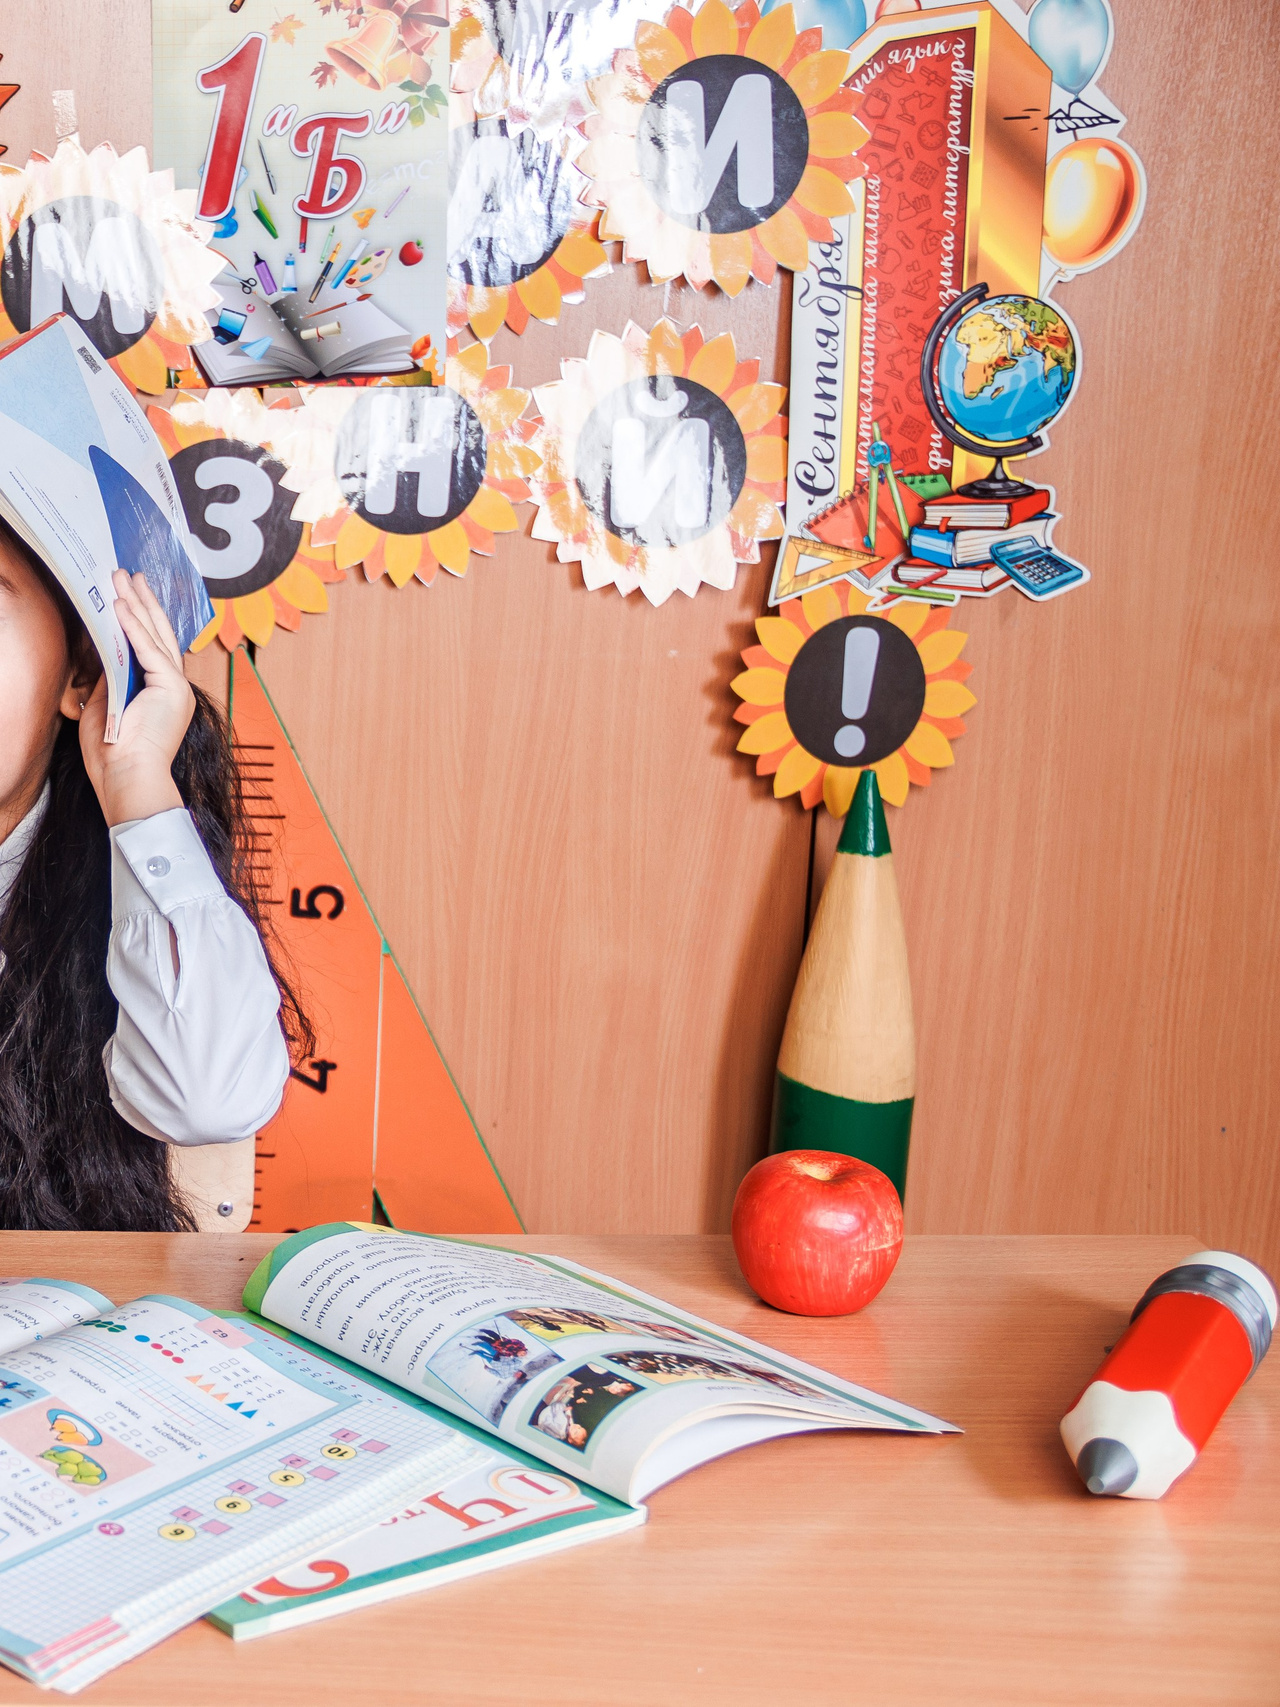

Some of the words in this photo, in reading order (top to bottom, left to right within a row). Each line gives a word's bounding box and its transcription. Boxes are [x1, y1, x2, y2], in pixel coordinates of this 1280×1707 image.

[884, 39, 950, 74] язык
[196, 32, 267, 221] 1
[669, 73, 775, 215] И
[950, 36, 979, 227] литература
[863, 173, 882, 268] химия
[30, 217, 148, 335] М
[794, 229, 864, 507] Сентября
[855, 276, 878, 479] математика
[364, 395, 457, 517] Н
[609, 383, 711, 529] Й
[833, 626, 881, 758] !
[290, 884, 344, 920] 5
[289, 1058, 338, 1094] 4
[296, 1247, 349, 1289] вопросов.
[299, 1260, 354, 1323] поработать!
[313, 1272, 359, 1330] Молодцы!
[355, 1266, 419, 1310] достижения
[375, 1288, 415, 1321] работу.
[2, 1312, 29, 1329] Какие
[336, 1314, 353, 1341] нам
[389, 1305, 410, 1324] что
[211, 1327, 229, 1339] 62
[360, 1328, 377, 1354] Эти
[370, 1327, 388, 1357] нуж-
[379, 1306, 423, 1363] встречать
[404, 1321, 444, 1375] интерес-
[113, 1399, 142, 1419] такие
[150, 1423, 192, 1452] Начерти
[326, 1442, 348, 1460] 10
[278, 1471, 294, 1484] 5
[224, 1497, 240, 1511] 9
[1, 1510, 40, 1537] Назови
[170, 1526, 184, 1539] 6
